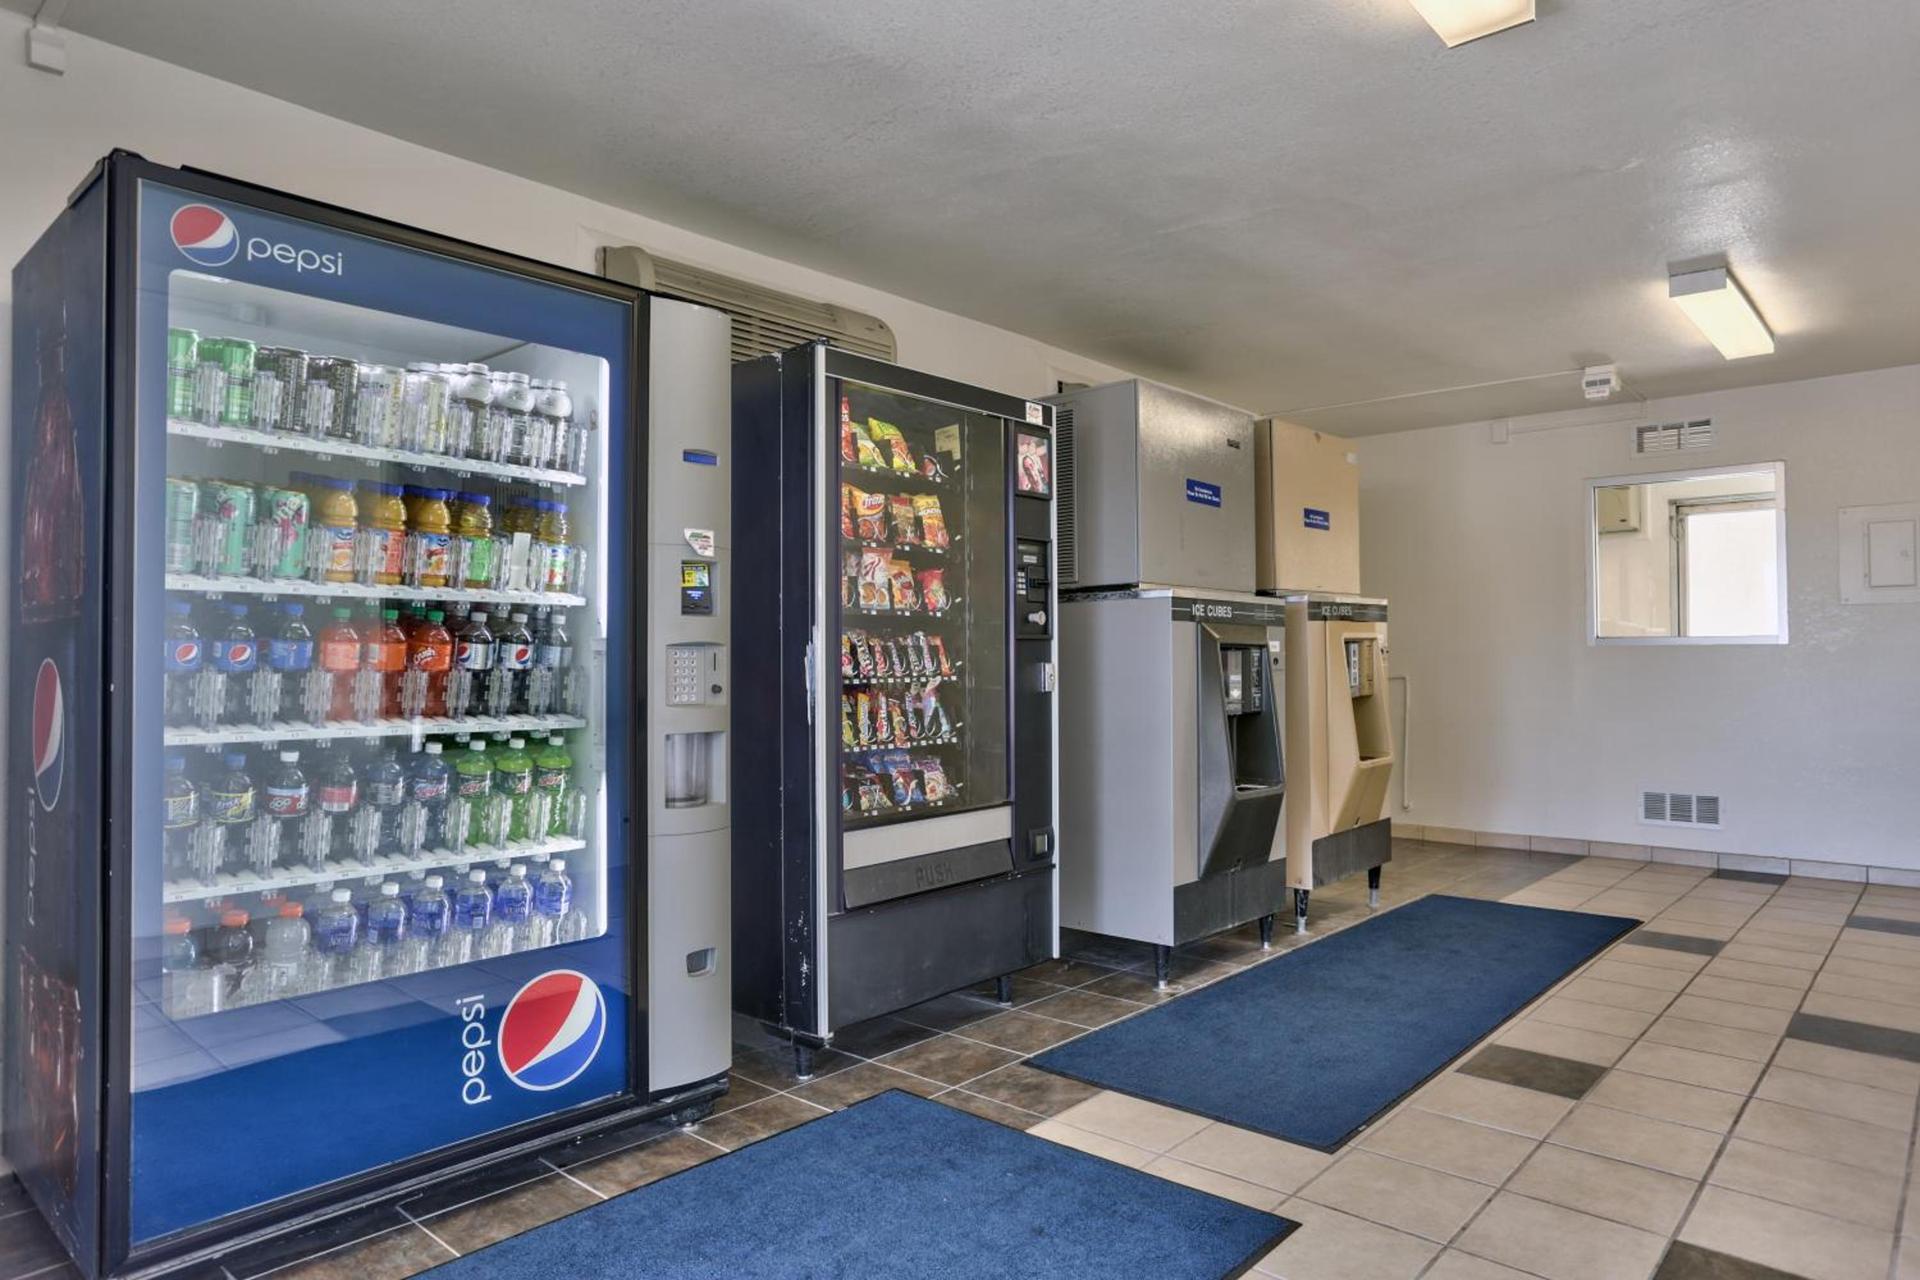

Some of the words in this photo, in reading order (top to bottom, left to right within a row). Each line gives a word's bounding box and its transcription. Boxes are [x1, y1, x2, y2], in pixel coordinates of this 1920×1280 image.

[247, 237, 343, 276] pepsi
[1192, 604, 1205, 617] ICE
[1207, 605, 1232, 618] CUBES
[27, 786, 38, 927] pepsi
[915, 862, 954, 888] PUSH
[456, 993, 492, 1105] pepsi
